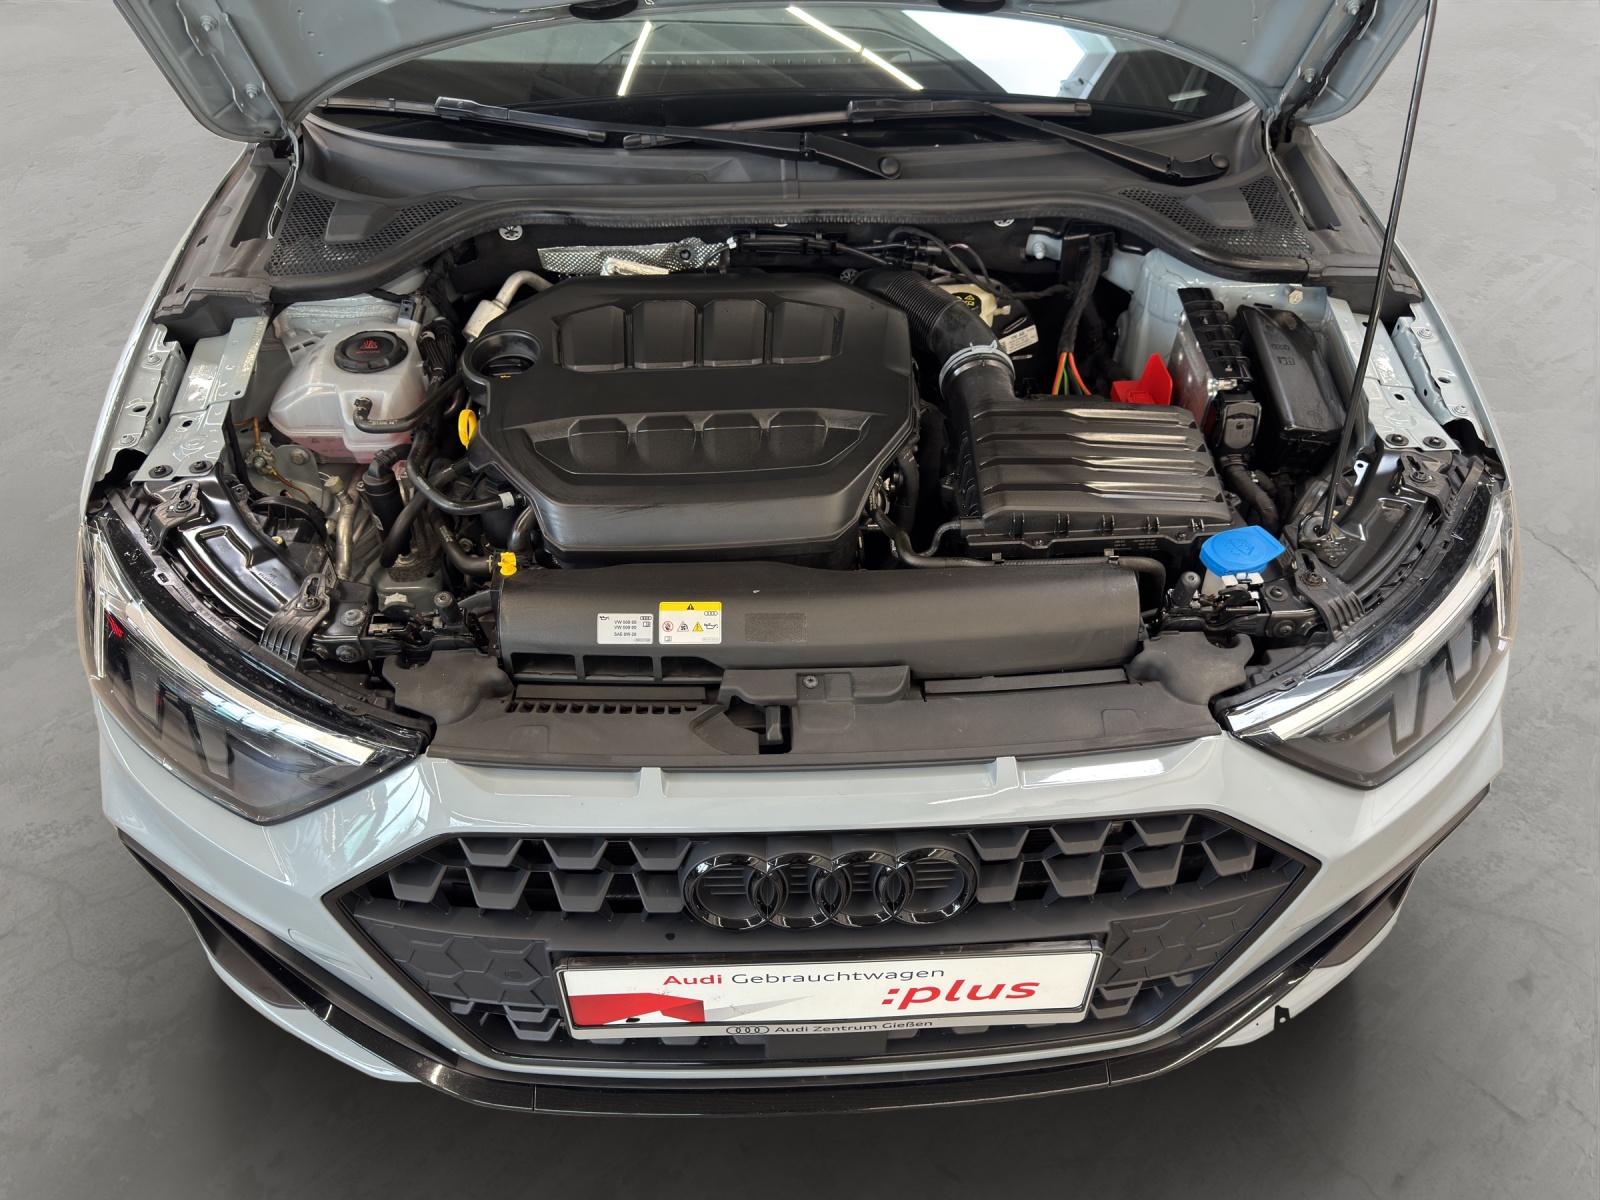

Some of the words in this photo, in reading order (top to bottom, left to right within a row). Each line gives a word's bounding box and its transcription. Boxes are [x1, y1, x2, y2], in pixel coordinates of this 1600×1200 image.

[663, 974, 722, 986] Audi
[731, 969, 945, 984] Gebrauchtwagen
[881, 979, 1041, 1010] :plus
[813, 1024, 878, 1032] Zentrum
[882, 1021, 933, 1029] Gießen
